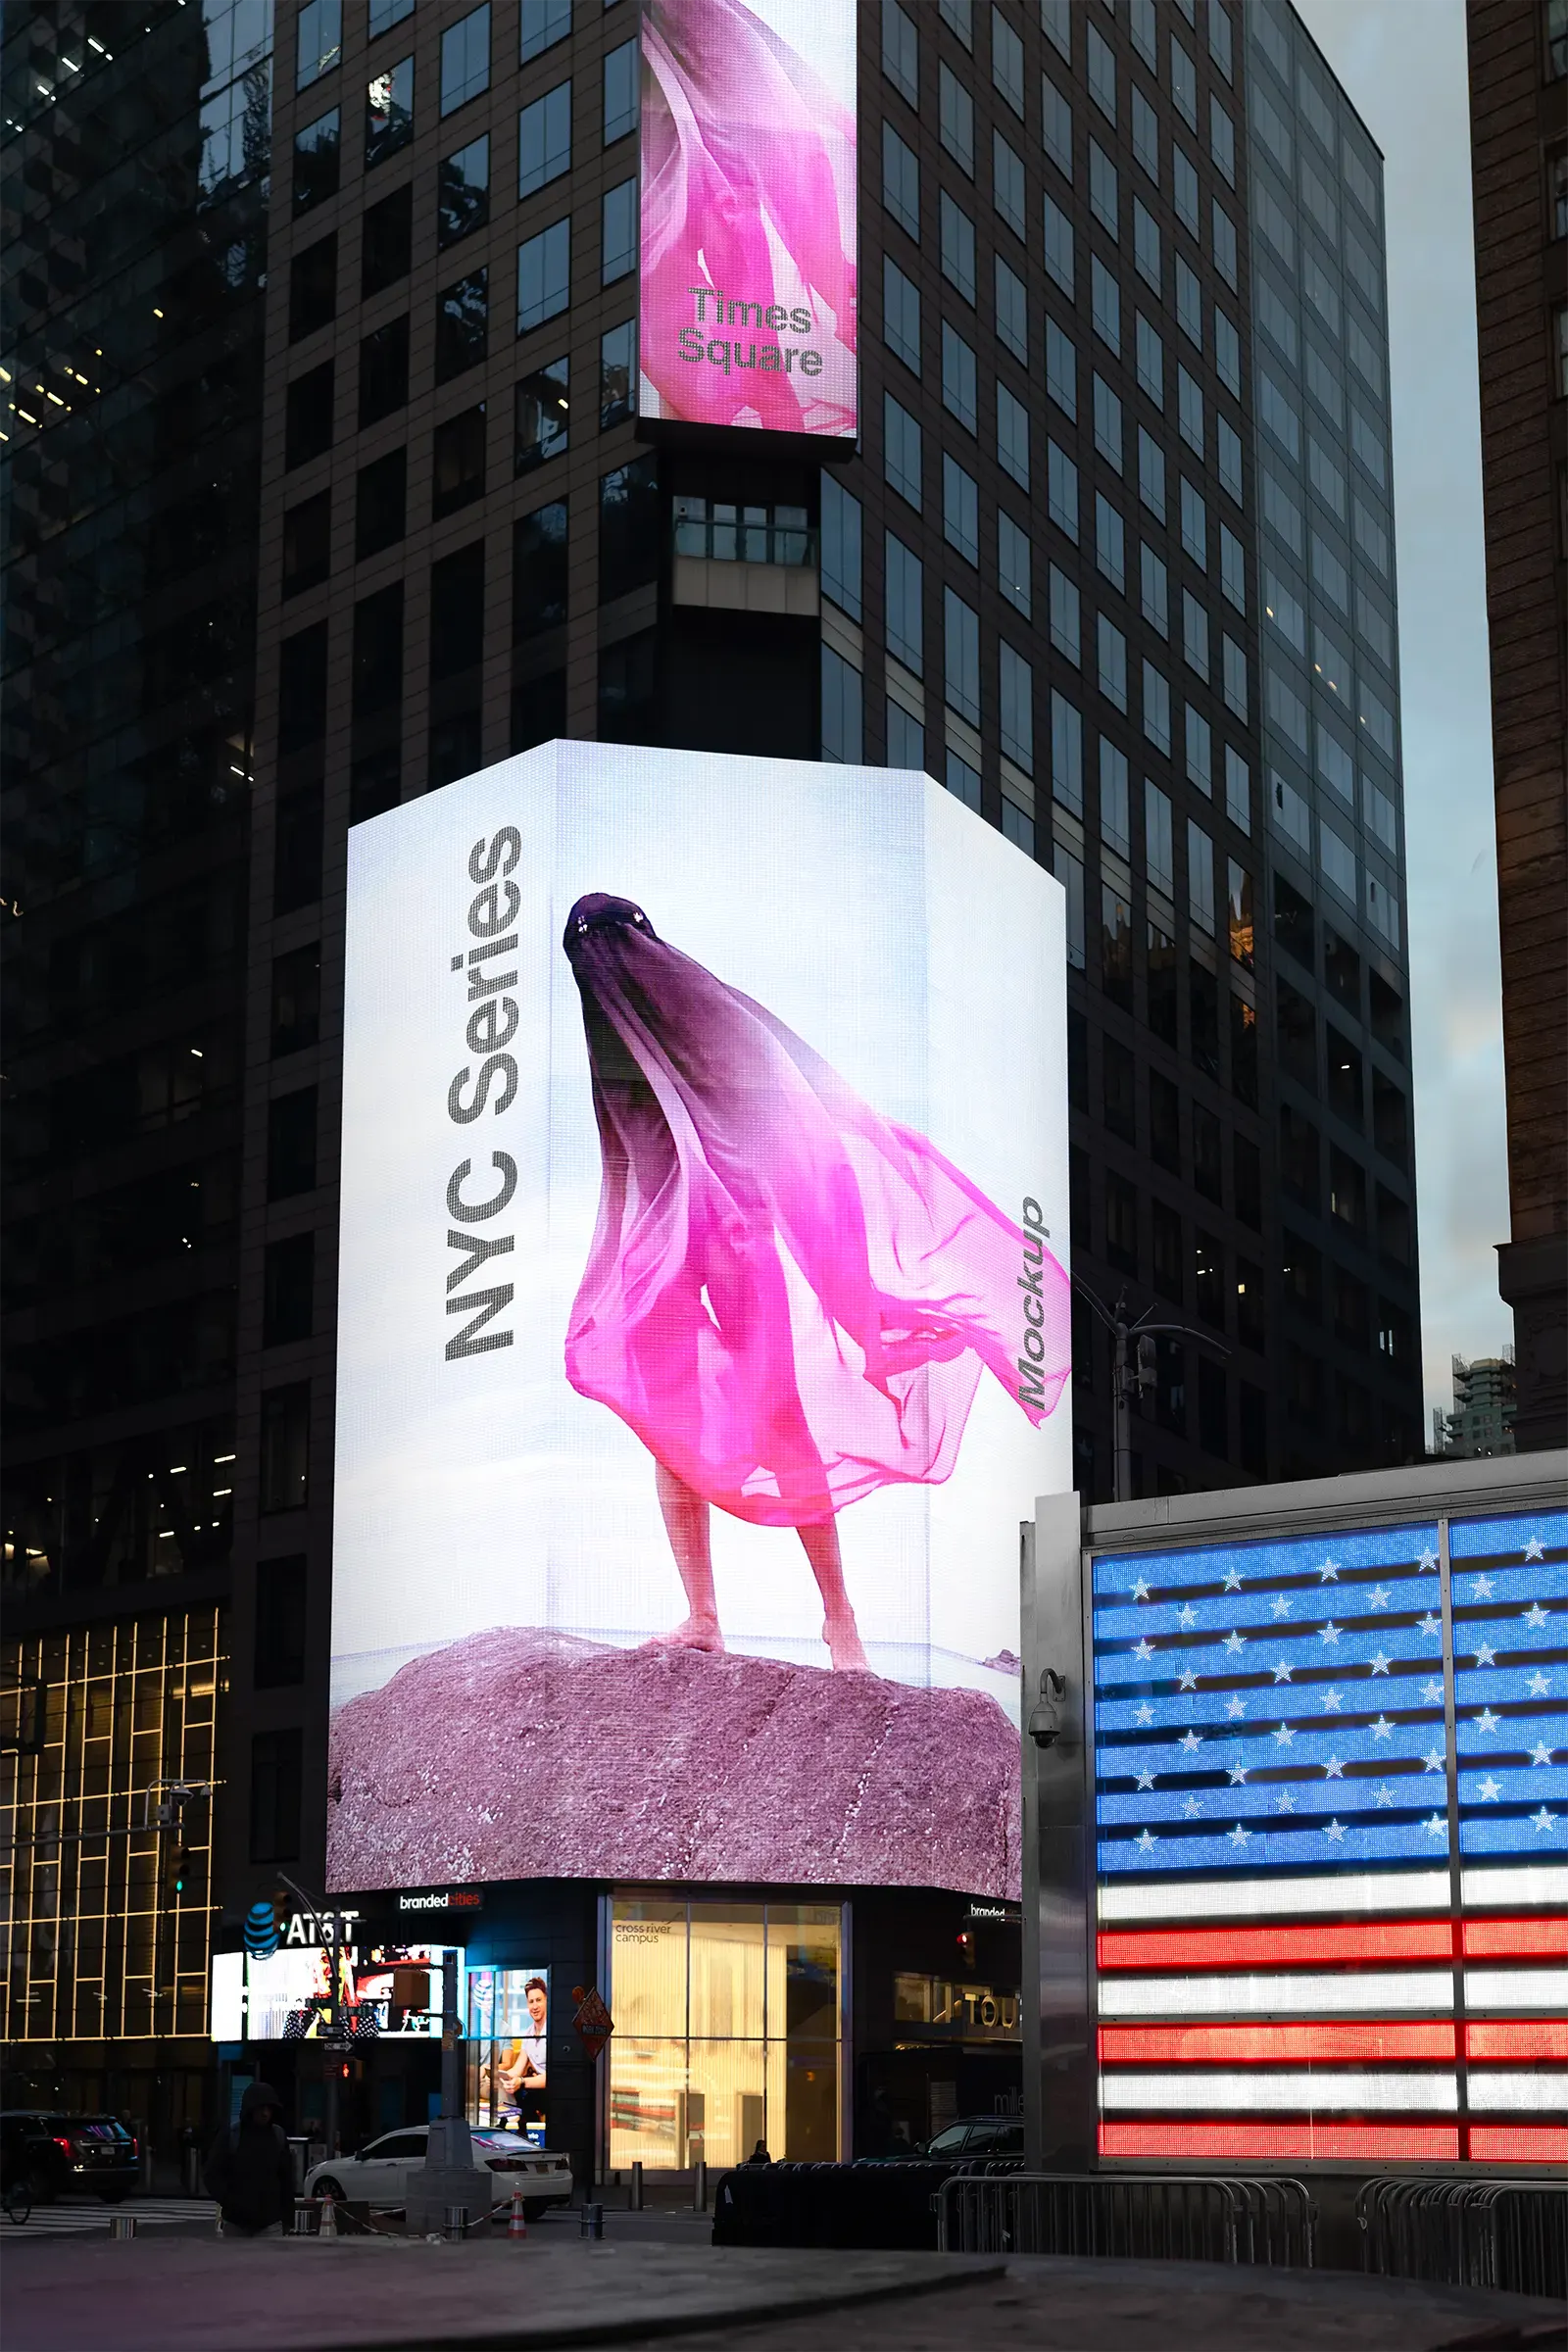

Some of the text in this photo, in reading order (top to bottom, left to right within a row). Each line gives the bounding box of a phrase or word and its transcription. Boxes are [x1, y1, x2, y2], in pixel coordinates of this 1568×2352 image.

[688, 287, 811, 333] Times
[677, 327, 823, 375] Square
[444, 825, 522, 1361] NYC Series
[1017, 1196, 1051, 1411] Mockup
[285, 1910, 360, 1945] AT&T
[615, 1923, 672, 1934] cross river
[615, 1934, 660, 1945] campus
